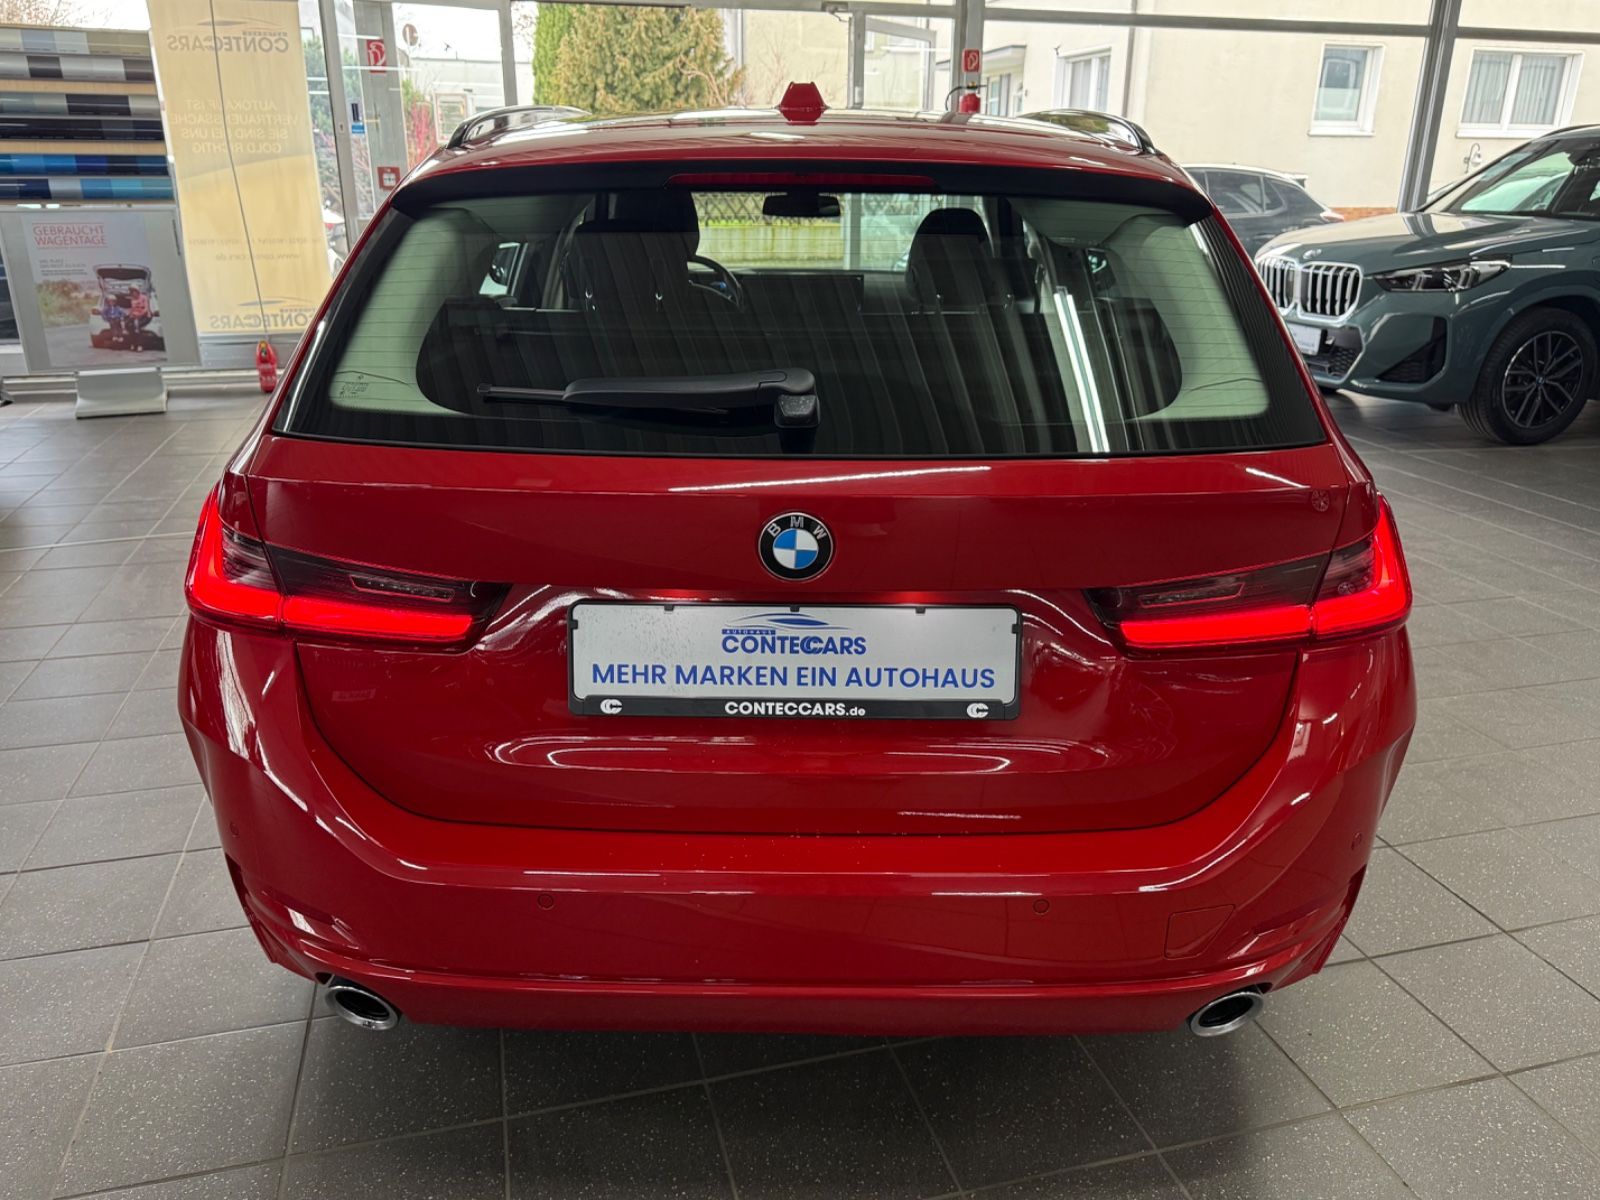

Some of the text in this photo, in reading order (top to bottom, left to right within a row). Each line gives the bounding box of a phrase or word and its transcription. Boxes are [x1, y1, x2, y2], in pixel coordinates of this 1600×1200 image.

[32, 225, 104, 235] GEBRAUCHT
[33, 235, 108, 246] WAGENTAGE
[767, 515, 828, 540] BMW
[722, 635, 867, 655] CONTECCARS
[592, 663, 995, 689] MEHR MARKEN EIN AUTOHAUS
[724, 701, 866, 717] CONTECCARS.de
